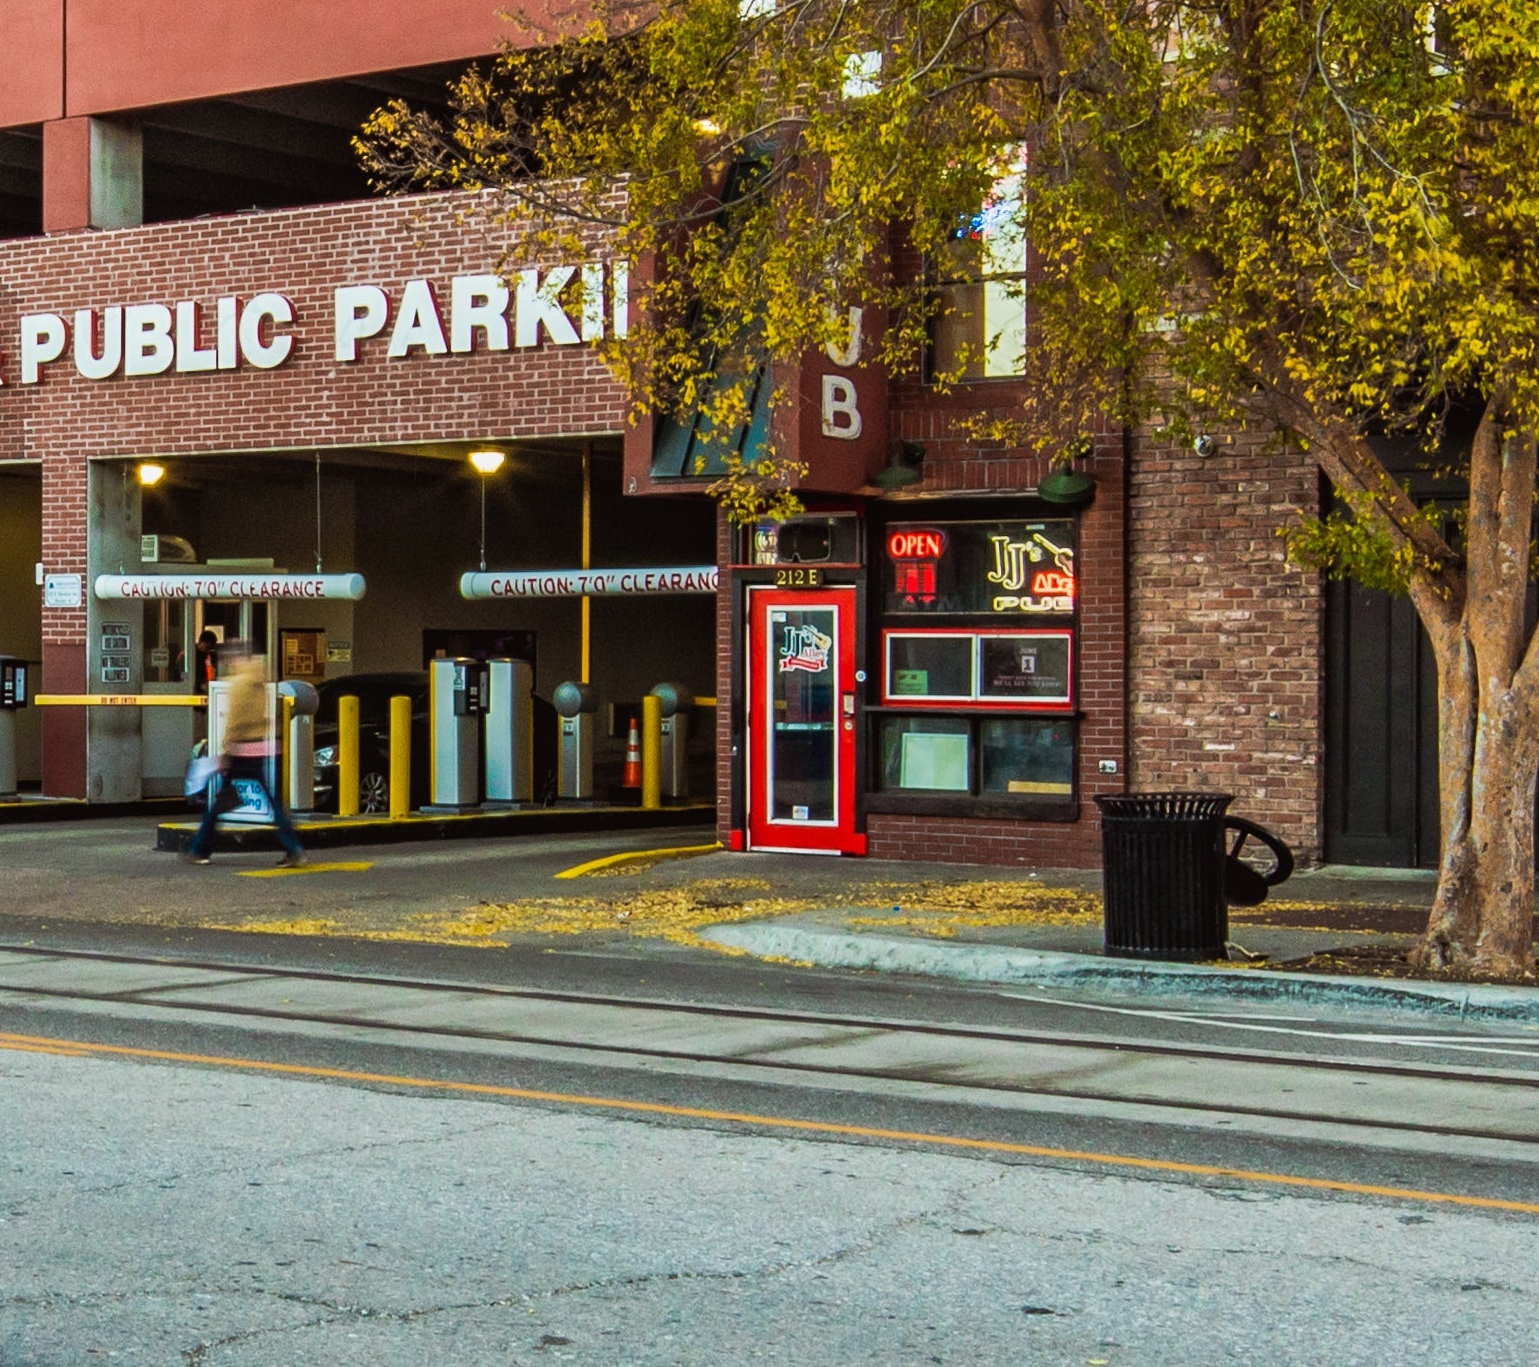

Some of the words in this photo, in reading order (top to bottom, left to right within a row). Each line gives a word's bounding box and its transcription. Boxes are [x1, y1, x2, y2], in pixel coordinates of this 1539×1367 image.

[21, 292, 295, 384] PUBLIC
[334, 261, 629, 362] PARKI
[890, 533, 941, 556] OPEN
[987, 535, 1043, 591] JJ's
[230, 580, 326, 598] CLEARANCE
[491, 576, 574, 597] CAUTION:
[620, 571, 718, 594] CLEARANC
[776, 570, 804, 585] 212
[809, 569, 817, 585] E
